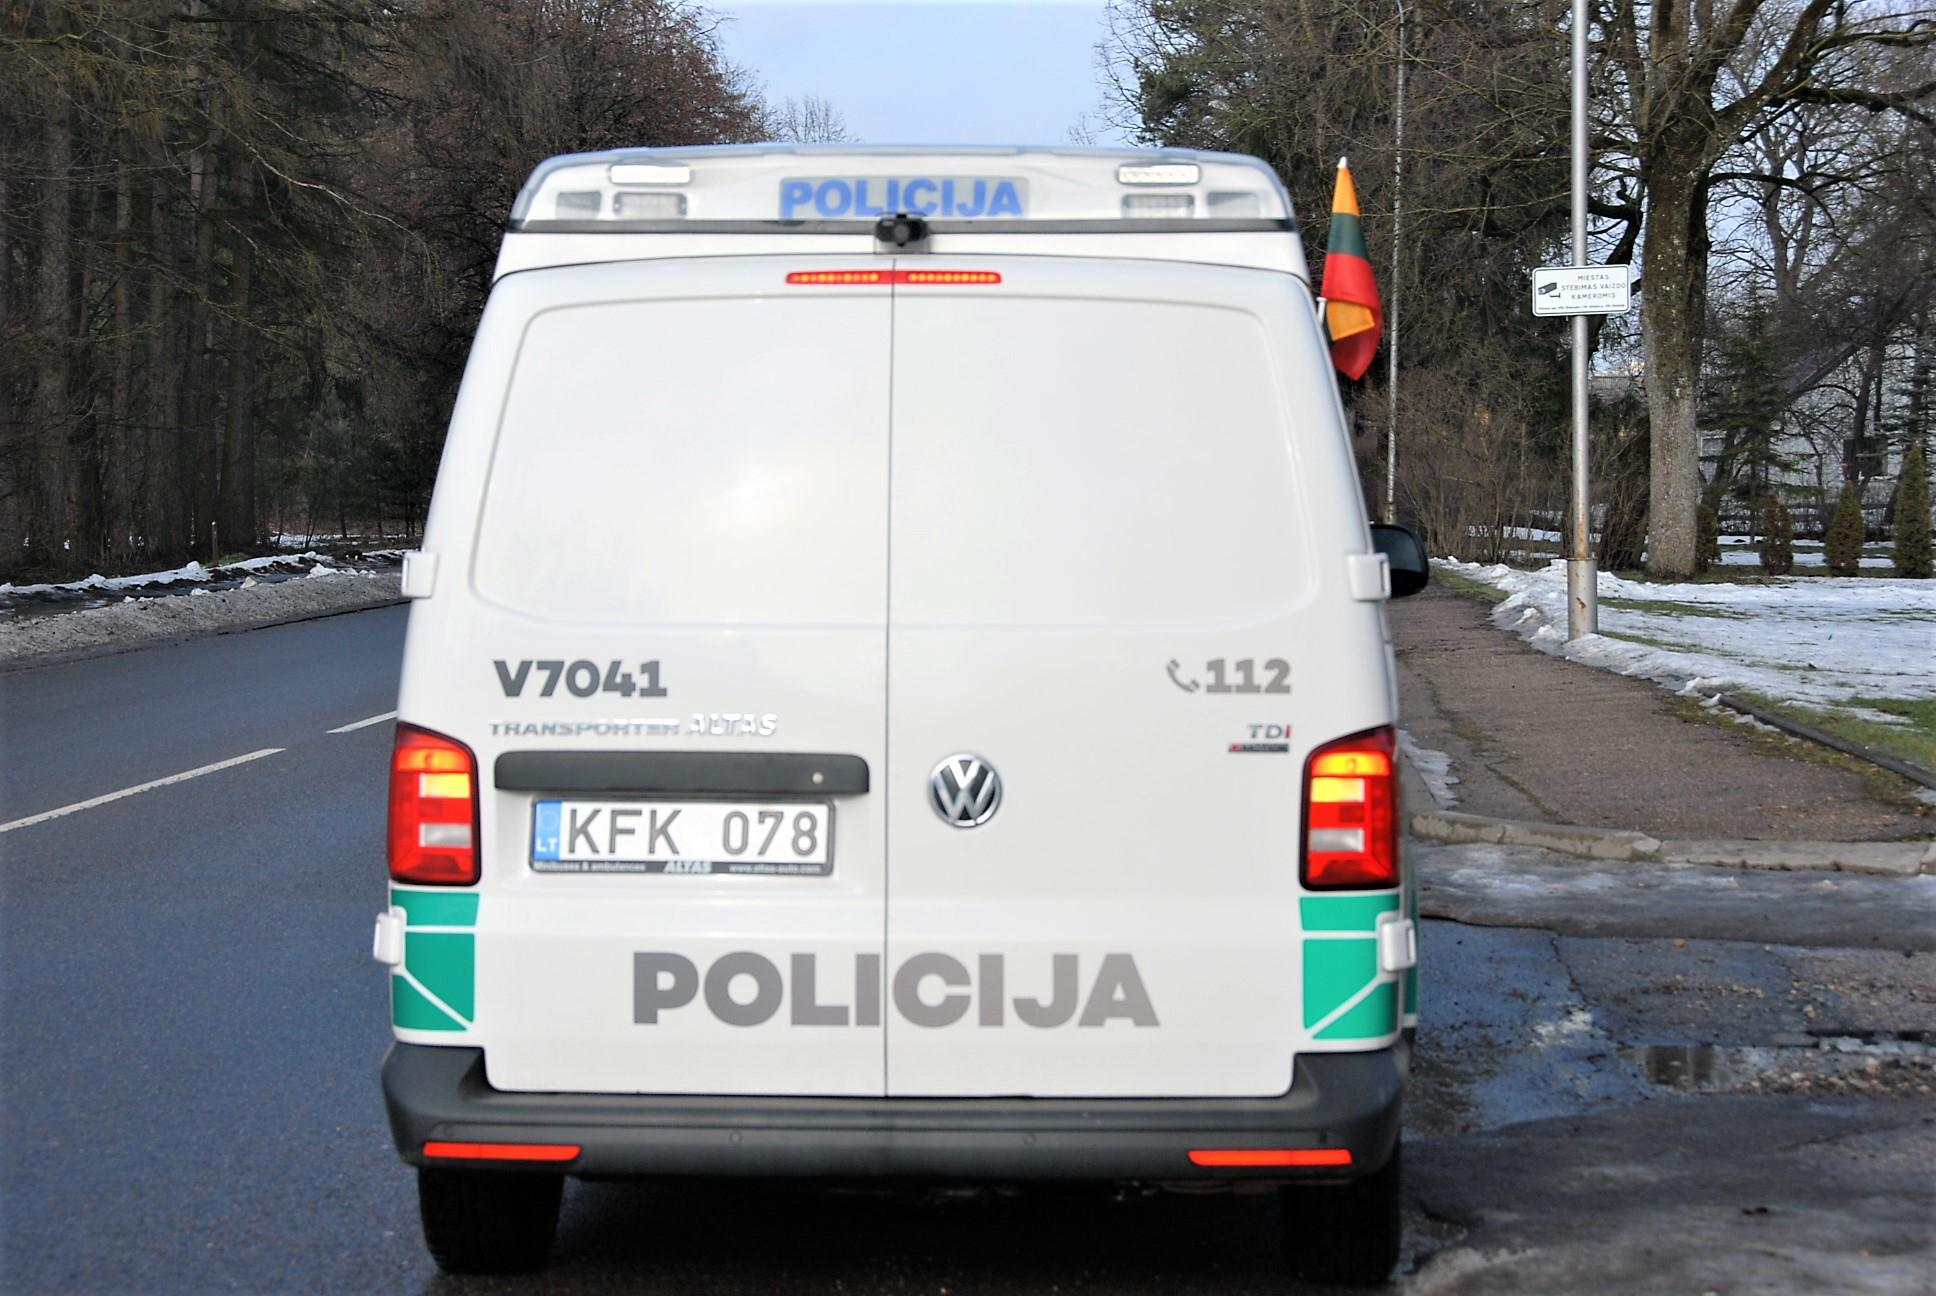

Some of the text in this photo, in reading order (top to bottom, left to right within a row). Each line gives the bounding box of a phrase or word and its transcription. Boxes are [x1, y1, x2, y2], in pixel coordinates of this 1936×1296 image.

[781, 177, 1024, 220] POLICIJA
[1599, 282, 1626, 290] VAIZDO
[493, 659, 667, 698] V7041
[1205, 657, 1291, 694] 112
[489, 713, 777, 737] TRANSPORTER ALTAS
[1247, 723, 1292, 739] TDI
[535, 837, 558, 853] LT
[568, 808, 818, 857] KFK 078
[663, 860, 712, 874] ALTAS
[633, 951, 1161, 1028] POLICIJA
